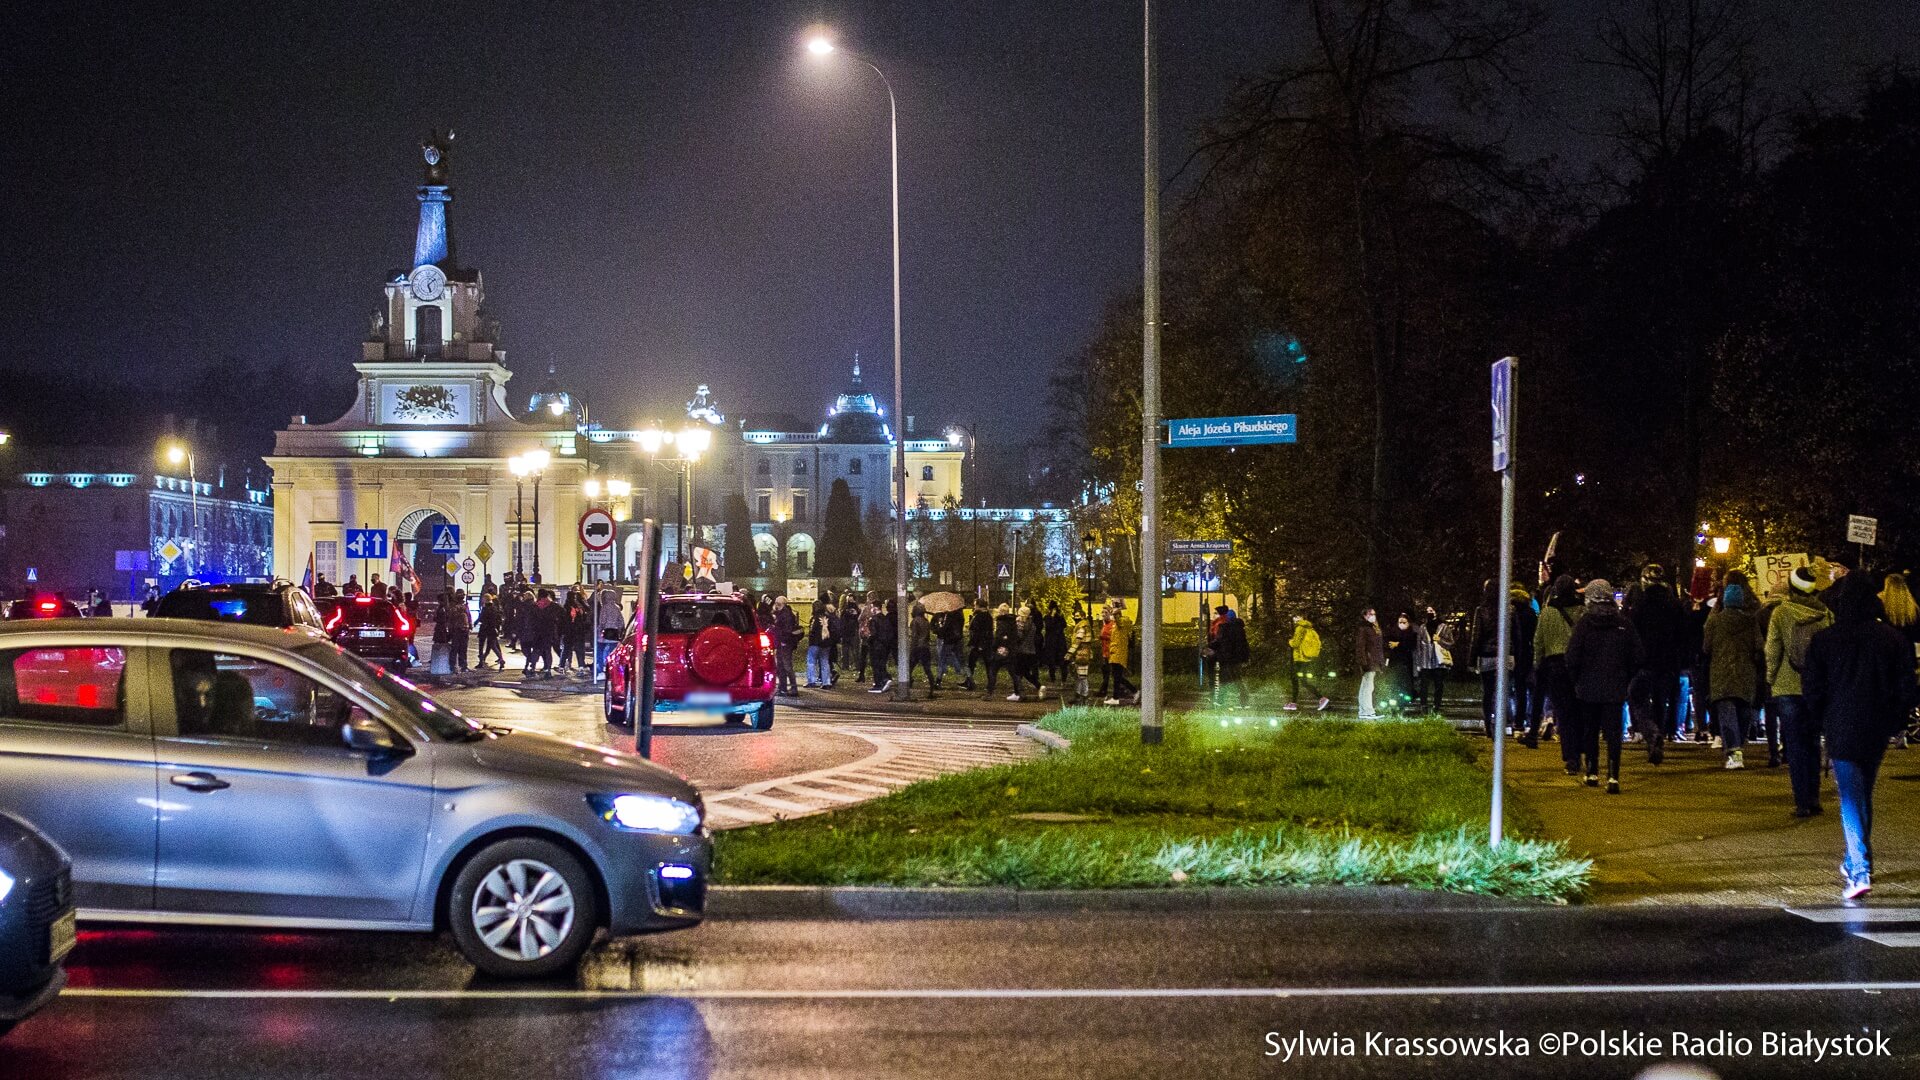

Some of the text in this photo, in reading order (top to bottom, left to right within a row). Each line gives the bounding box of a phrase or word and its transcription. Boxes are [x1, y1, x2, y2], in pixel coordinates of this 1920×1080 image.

[1178, 420, 1288, 437] Aleja Józefa Piłsudskiego
[1766, 556, 1792, 569] PiS
